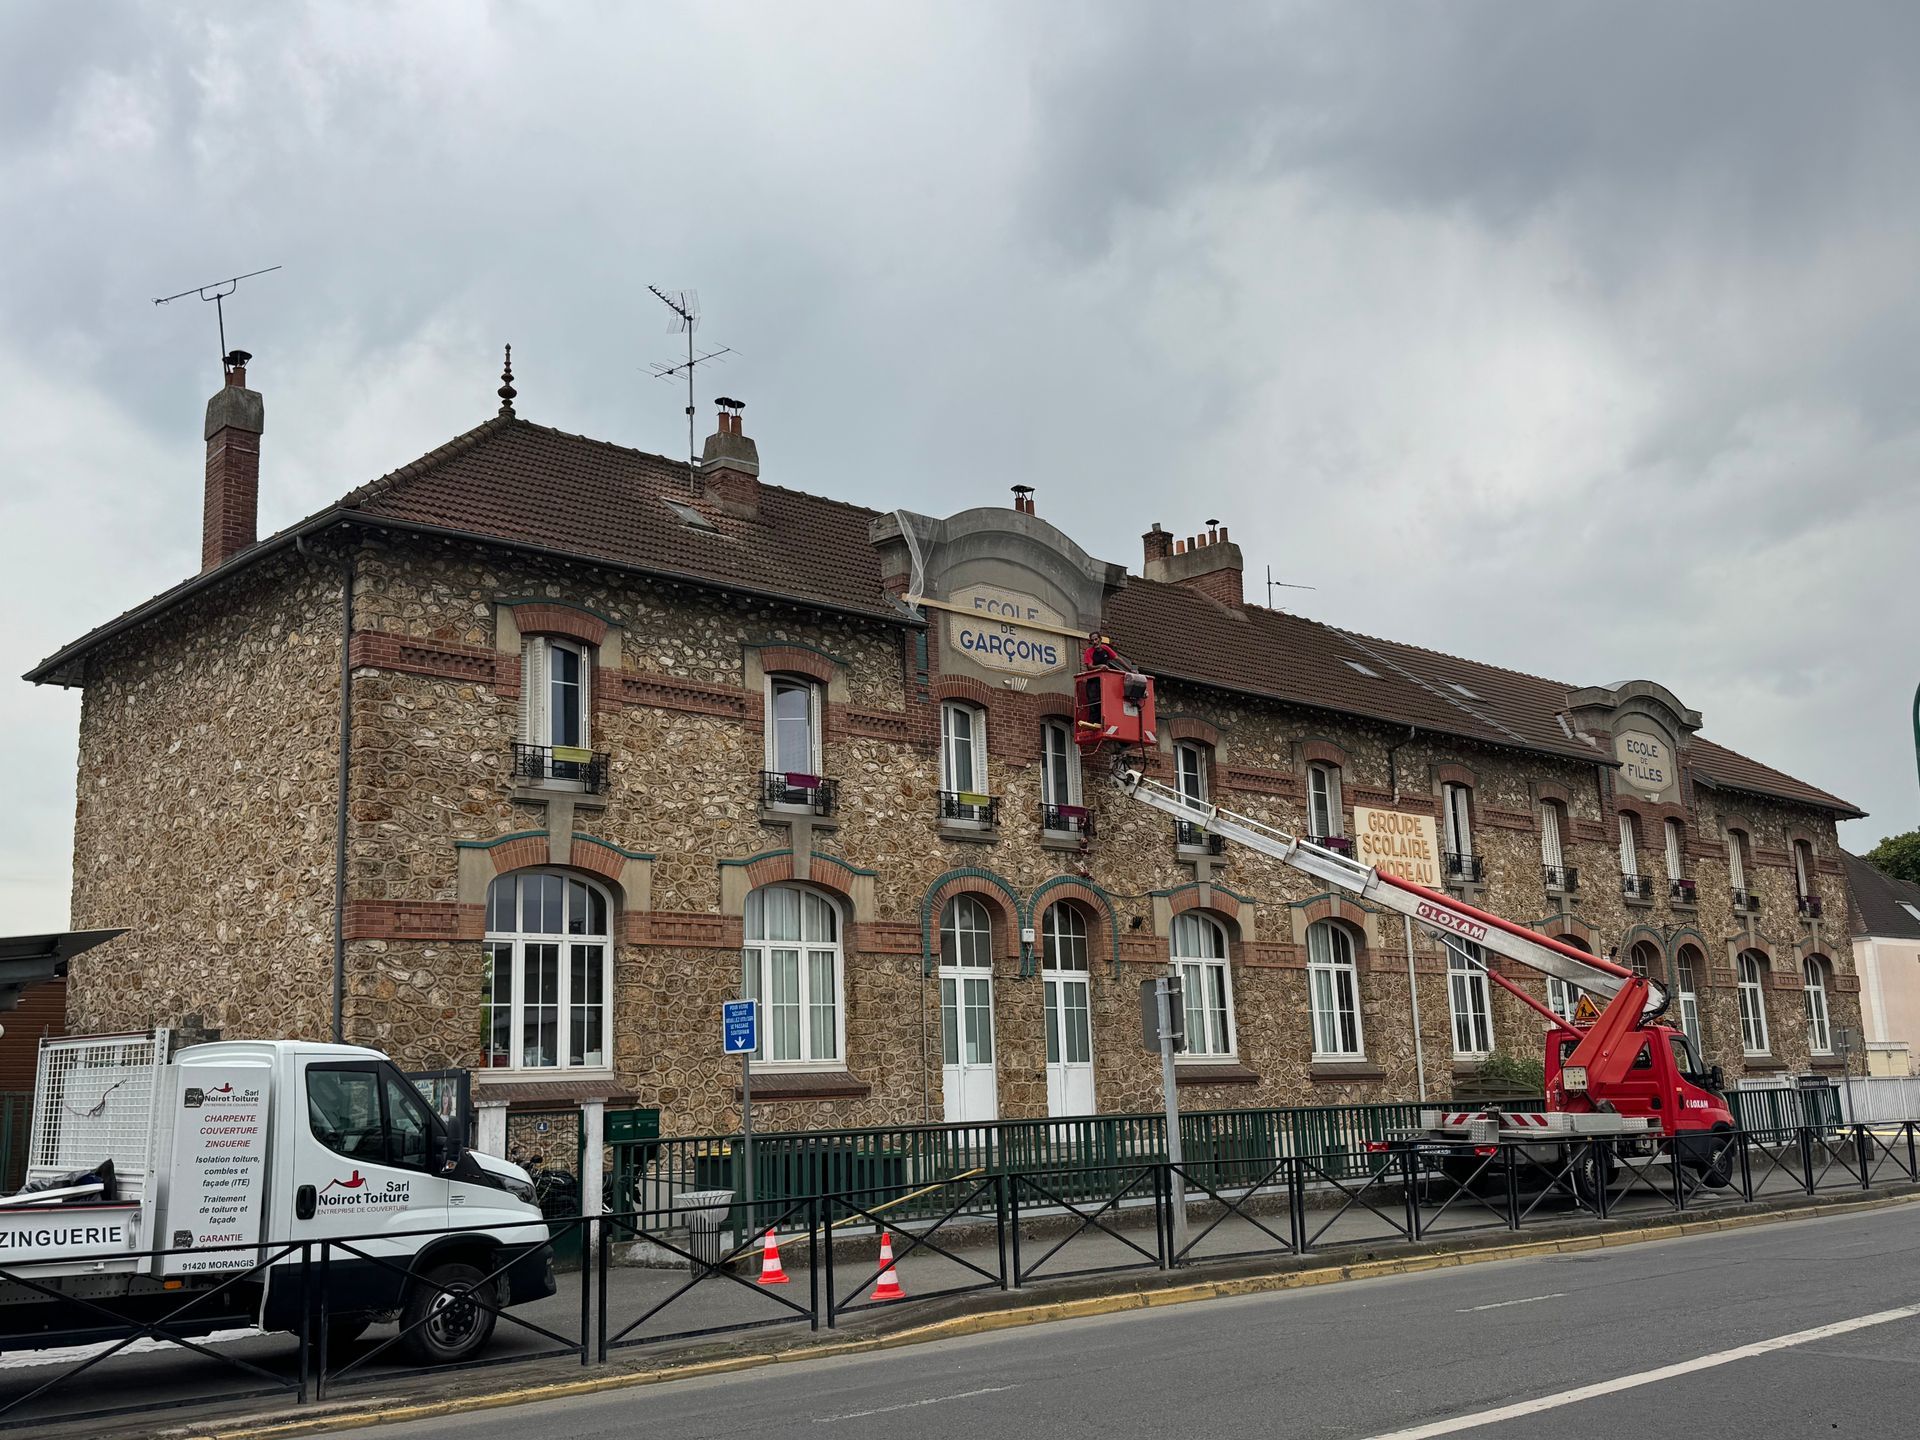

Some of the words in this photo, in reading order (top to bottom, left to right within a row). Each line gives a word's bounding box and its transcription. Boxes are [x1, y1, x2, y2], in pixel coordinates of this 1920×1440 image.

[1001, 624, 1016, 635] DE
[960, 630, 1057, 665] GARÇONS
[1627, 739, 1658, 758] ECOLE
[1628, 763, 1663, 782] FILLES
[1368, 811, 1424, 838] GROUPE
[1362, 833, 1431, 860] SCOLAIRE
[1429, 909, 1485, 939] LOXAM
[244, 1089, 259, 1097] Sarl
[200, 1127, 258, 1135] COUVERTURE
[205, 1140, 251, 1148] ZINGUERIE
[195, 1155, 231, 1164] Isolation
[232, 1155, 260, 1164] toiture,
[204, 1167, 239, 1175] combles
[202, 1179, 230, 1188] façade
[231, 1178, 250, 1188] (ITE)
[386, 1180, 410, 1192] Sarl
[203, 1195, 246, 1203] Traitement
[318, 1193, 361, 1206] Noirot
[364, 1192, 410, 1204] Toiture
[199, 1206, 209, 1214] de
[211, 1205, 238, 1213] toiture
[317, 1207, 355, 1215] ENTREPRISE
[366, 1205, 409, 1213] COUVERTURE
[209, 1216, 236, 1225] façade
[0, 1226, 122, 1248] ZINGUERIE
[199, 1233, 243, 1243] GARANTIE
[182, 1262, 207, 1271] 91420
[208, 1259, 255, 1269] MORANGIS
